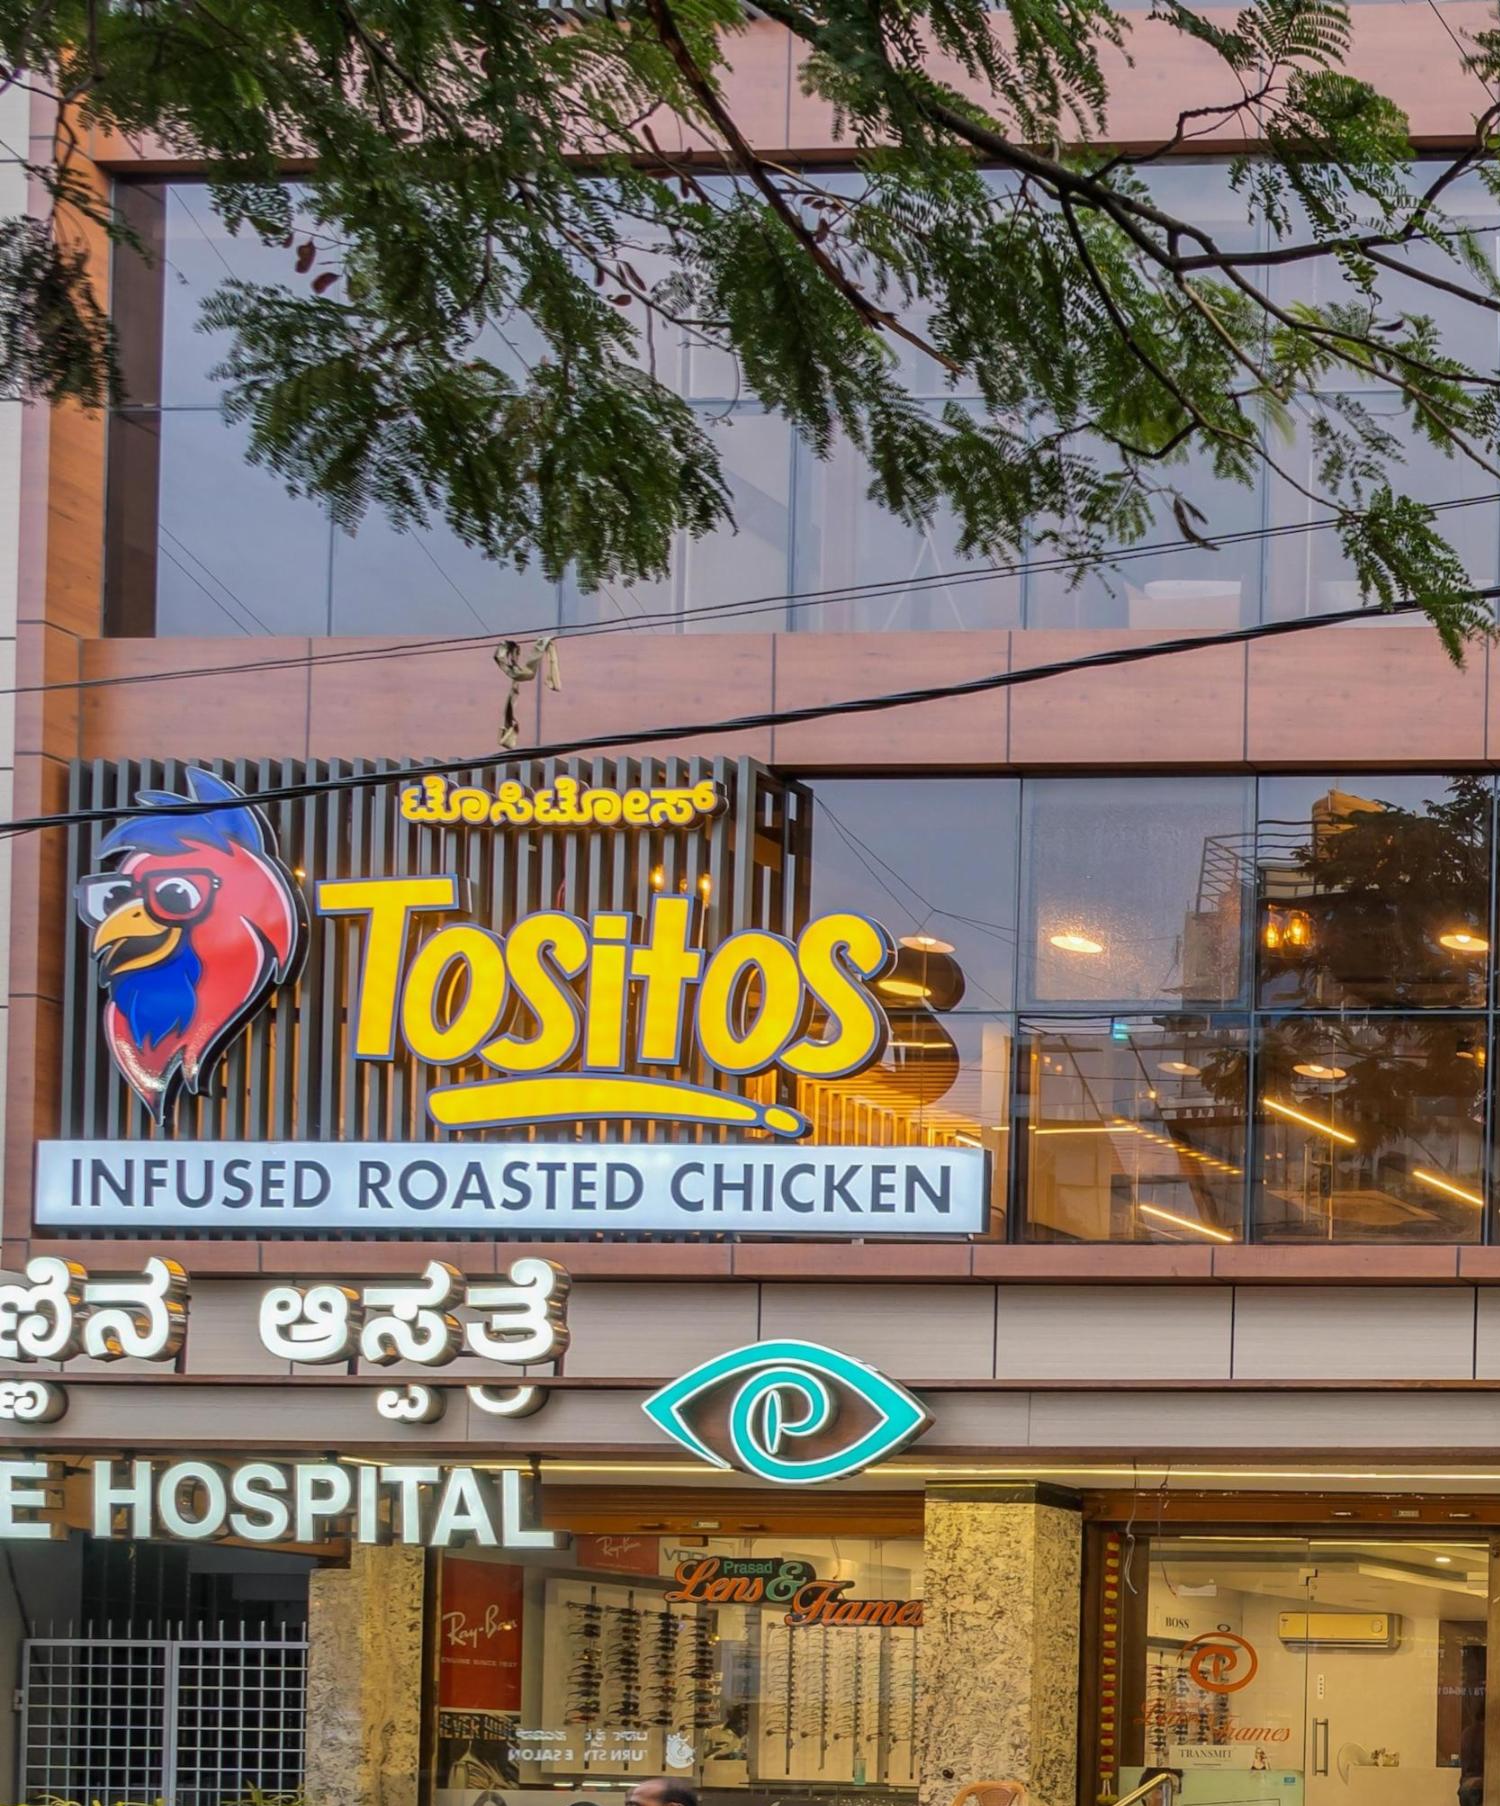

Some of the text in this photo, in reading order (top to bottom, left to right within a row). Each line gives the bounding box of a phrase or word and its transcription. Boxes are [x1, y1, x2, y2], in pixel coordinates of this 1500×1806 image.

[316, 873, 897, 1078] Tositos
[71, 1159, 952, 1215] INFUSED ROASTED CHICKEN
[92, 1461, 555, 1547] HOSPITAL
[665, 1557, 806, 1602] Lens &
[723, 1561, 773, 1575] Prasad
[1165, 1617, 1189, 1629] BOSS
